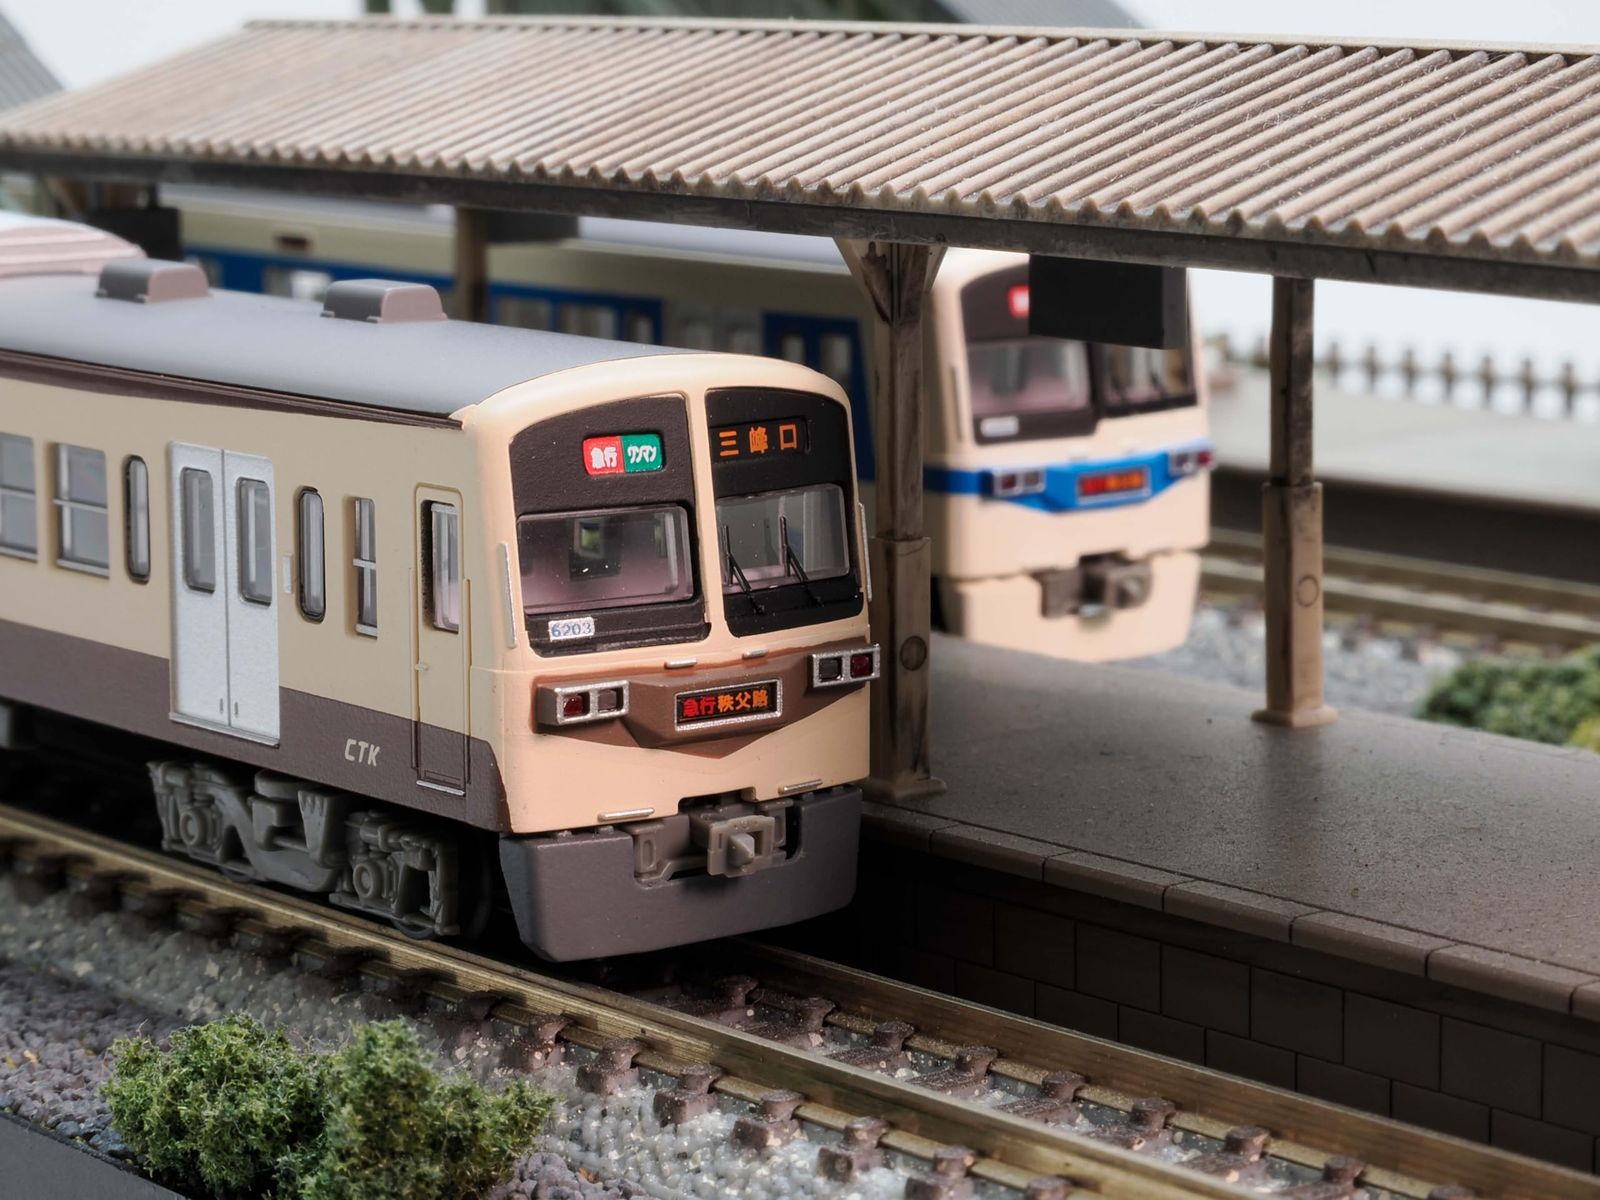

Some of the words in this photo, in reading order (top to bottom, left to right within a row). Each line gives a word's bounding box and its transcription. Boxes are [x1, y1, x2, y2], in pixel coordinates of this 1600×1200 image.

[590, 446, 618, 469] 急行
[551, 622, 592, 637] 6203
[345, 738, 380, 767] CTK
